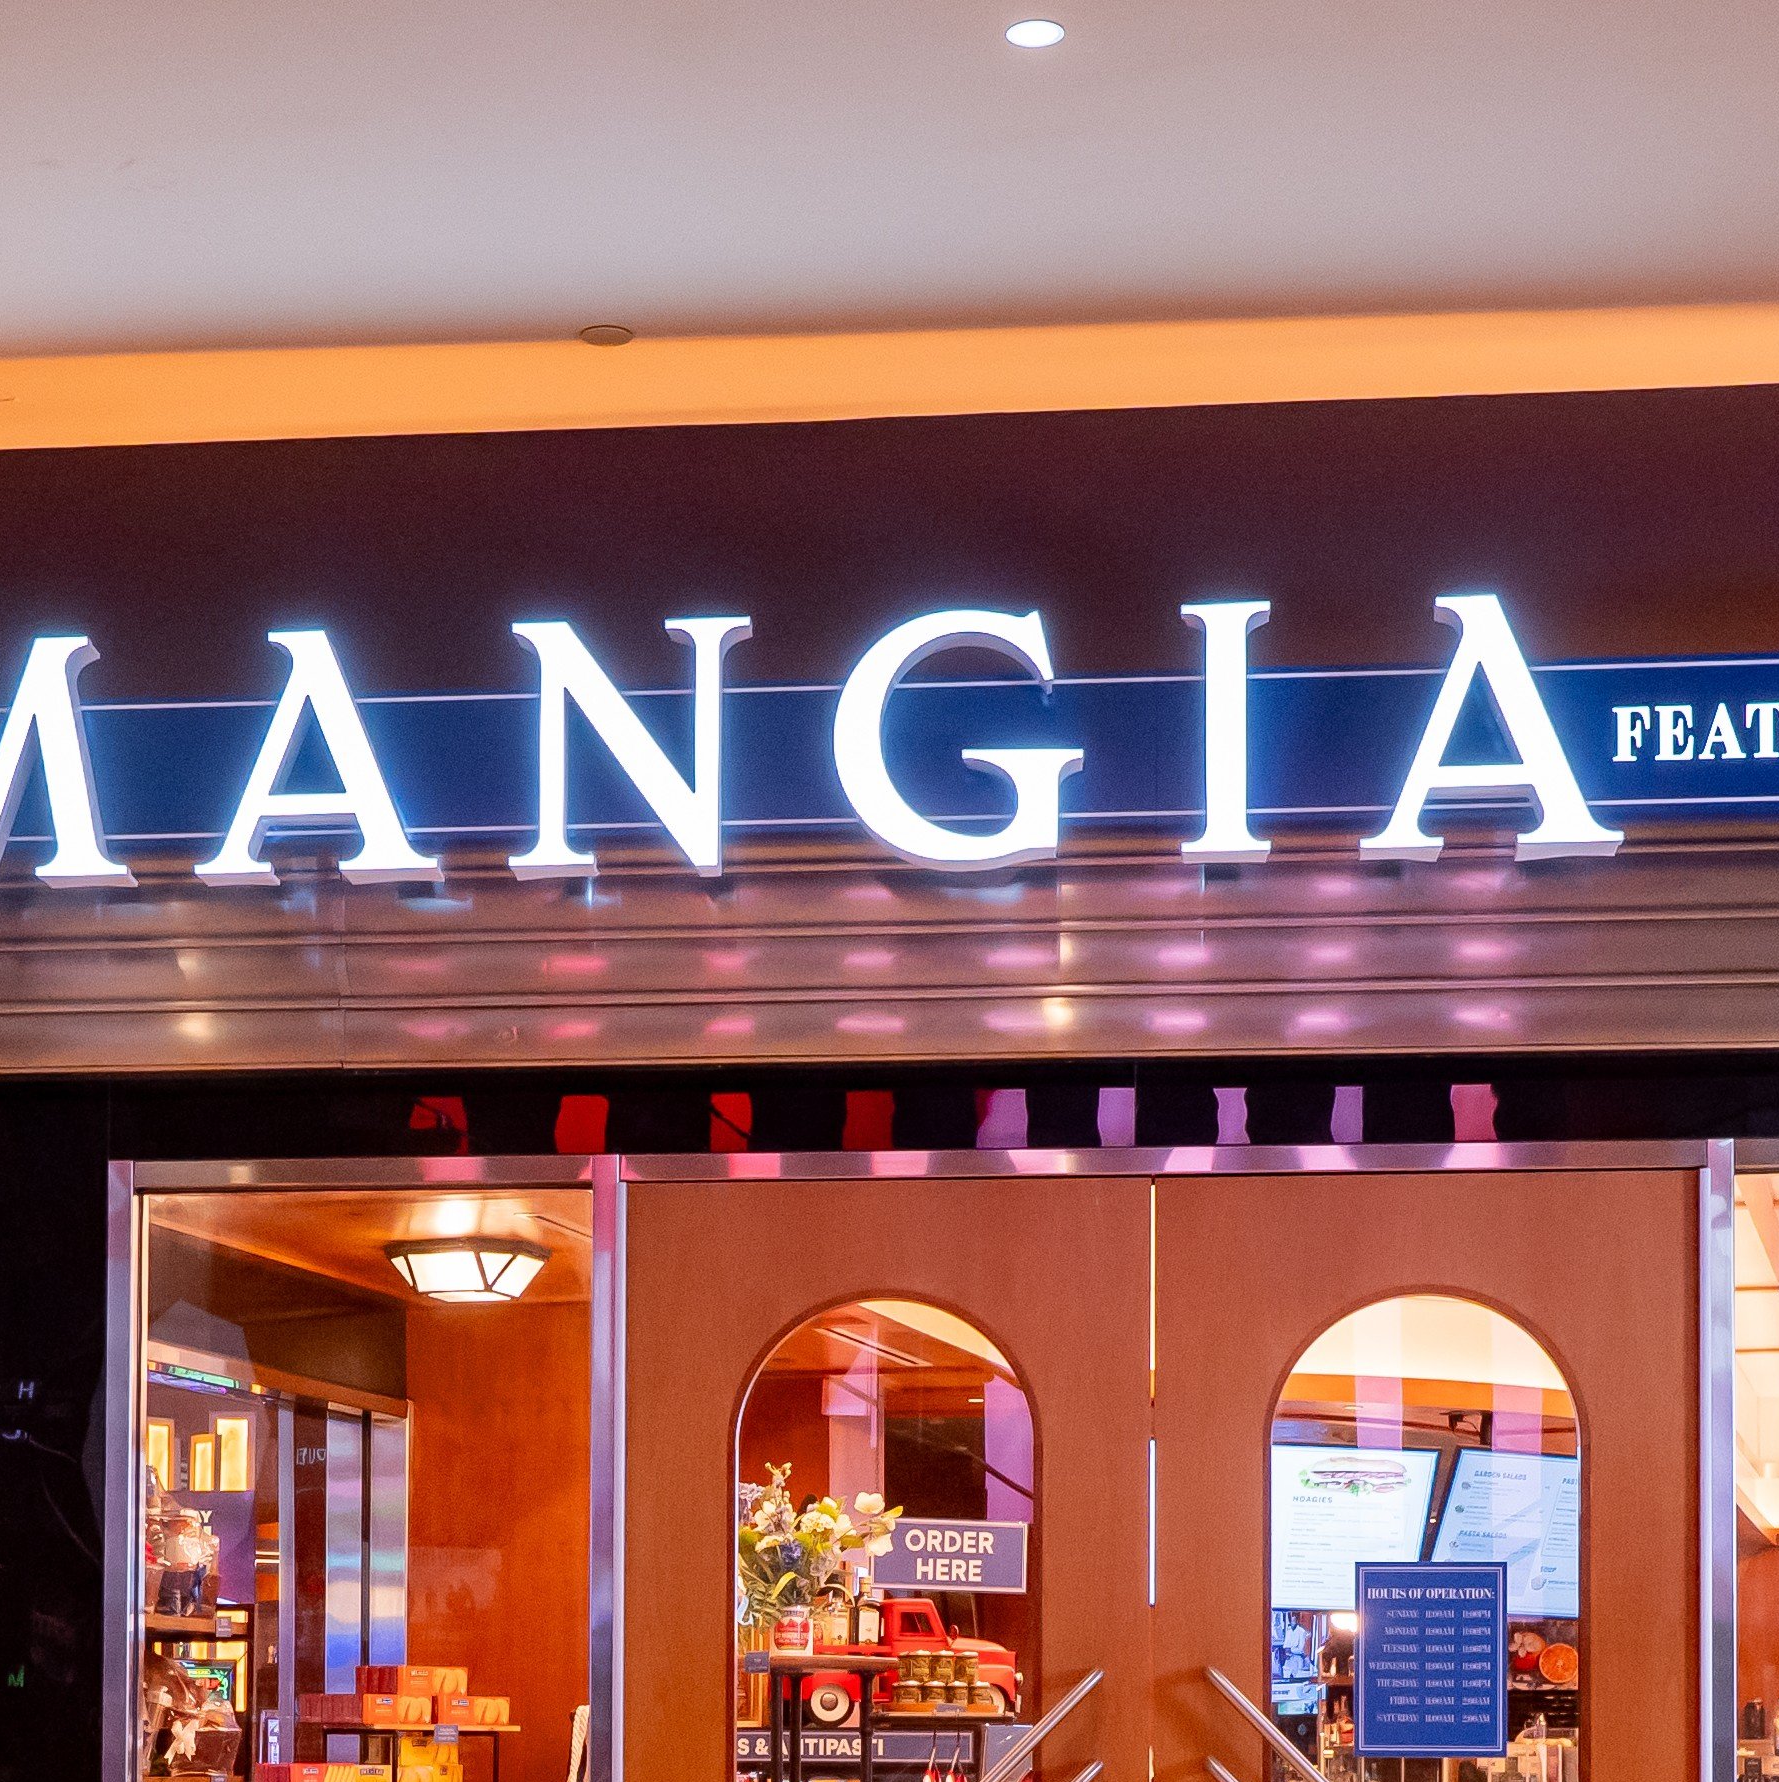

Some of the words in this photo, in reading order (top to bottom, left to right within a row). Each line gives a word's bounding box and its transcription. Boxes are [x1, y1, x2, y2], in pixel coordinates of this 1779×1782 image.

[1292, 1495, 1334, 1504] HOAGIES
[905, 1528, 994, 1556] ORDER
[915, 1558, 983, 1583] HERE
[1367, 1588, 1406, 1600] HOURS
[1409, 1588, 1424, 1600] OF
[1426, 1588, 1495, 1600] OPERATION:
